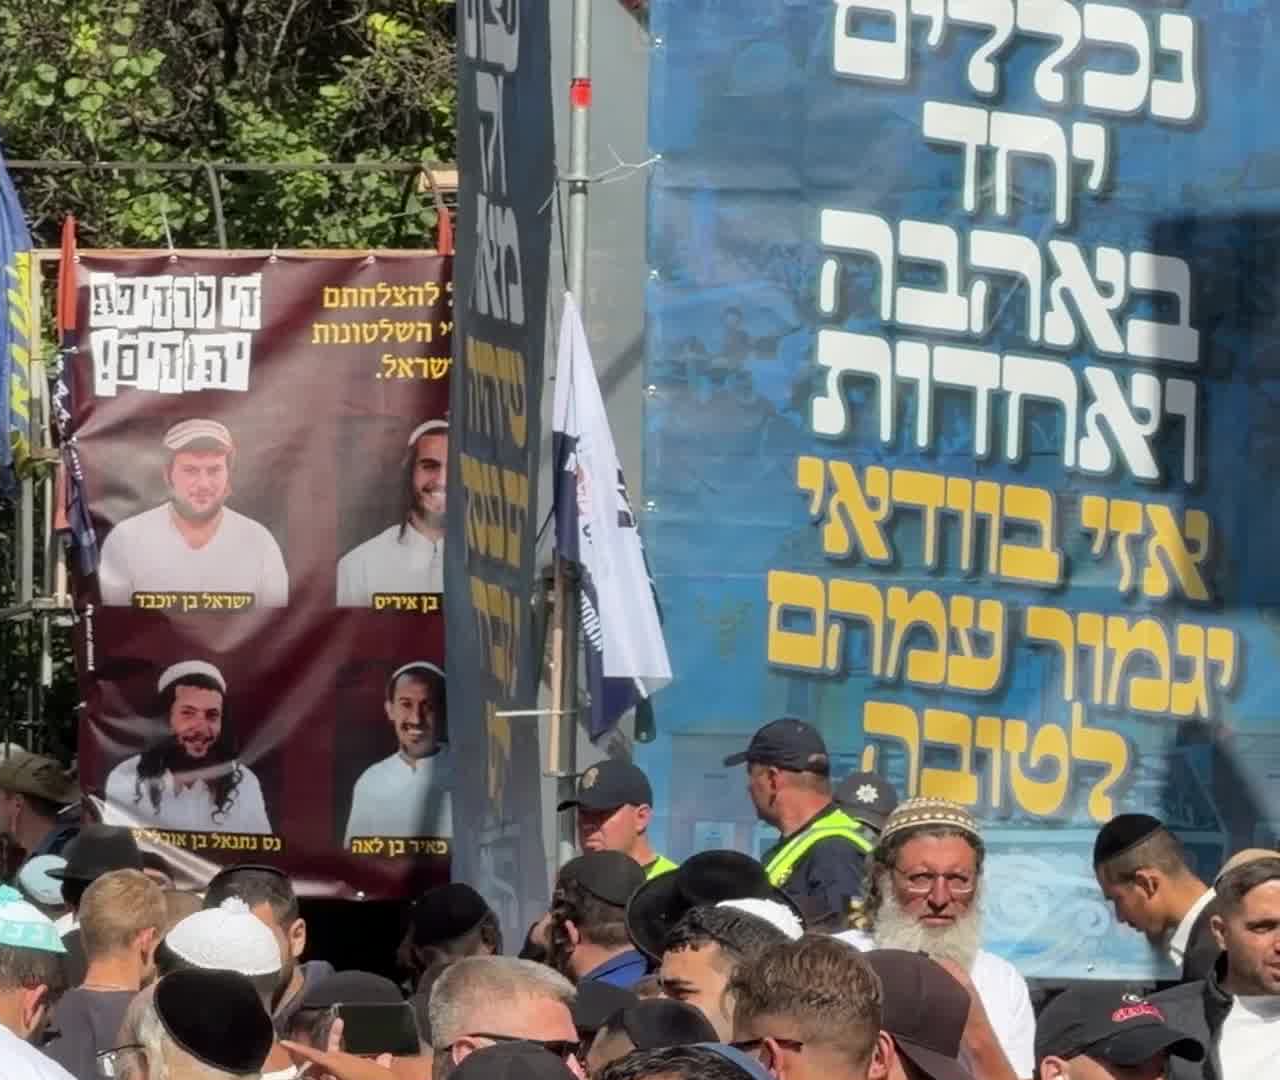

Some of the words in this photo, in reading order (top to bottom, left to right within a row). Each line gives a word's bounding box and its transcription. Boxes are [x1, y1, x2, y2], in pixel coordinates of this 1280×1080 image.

[833, 0, 1198, 121] נכללים
[923, 101, 1107, 225] יחד
[231, 283, 258, 318] די
[323, 281, 440, 309] להצלחתם
[819, 209, 1200, 363] באהבה
[311, 318, 433, 344] השלטונות
[100, 339, 244, 383] יהודים!
[811, 329, 1198, 483] ואחדות
[796, 456, 1061, 586] בוודאי
[1081, 496, 1210, 600] אזי
[183, 595, 198, 613] בן
[203, 593, 252, 609] ישראל
[421, 595, 438, 613] בן
[766, 569, 1004, 691] עמהם
[1027, 606, 1235, 717] יגמור
[862, 700, 1129, 823] לטובה
[191, 833, 208, 850] בן
[210, 832, 257, 850] נתנאל
[351, 837, 384, 854] לאה
[389, 839, 406, 856] בן
